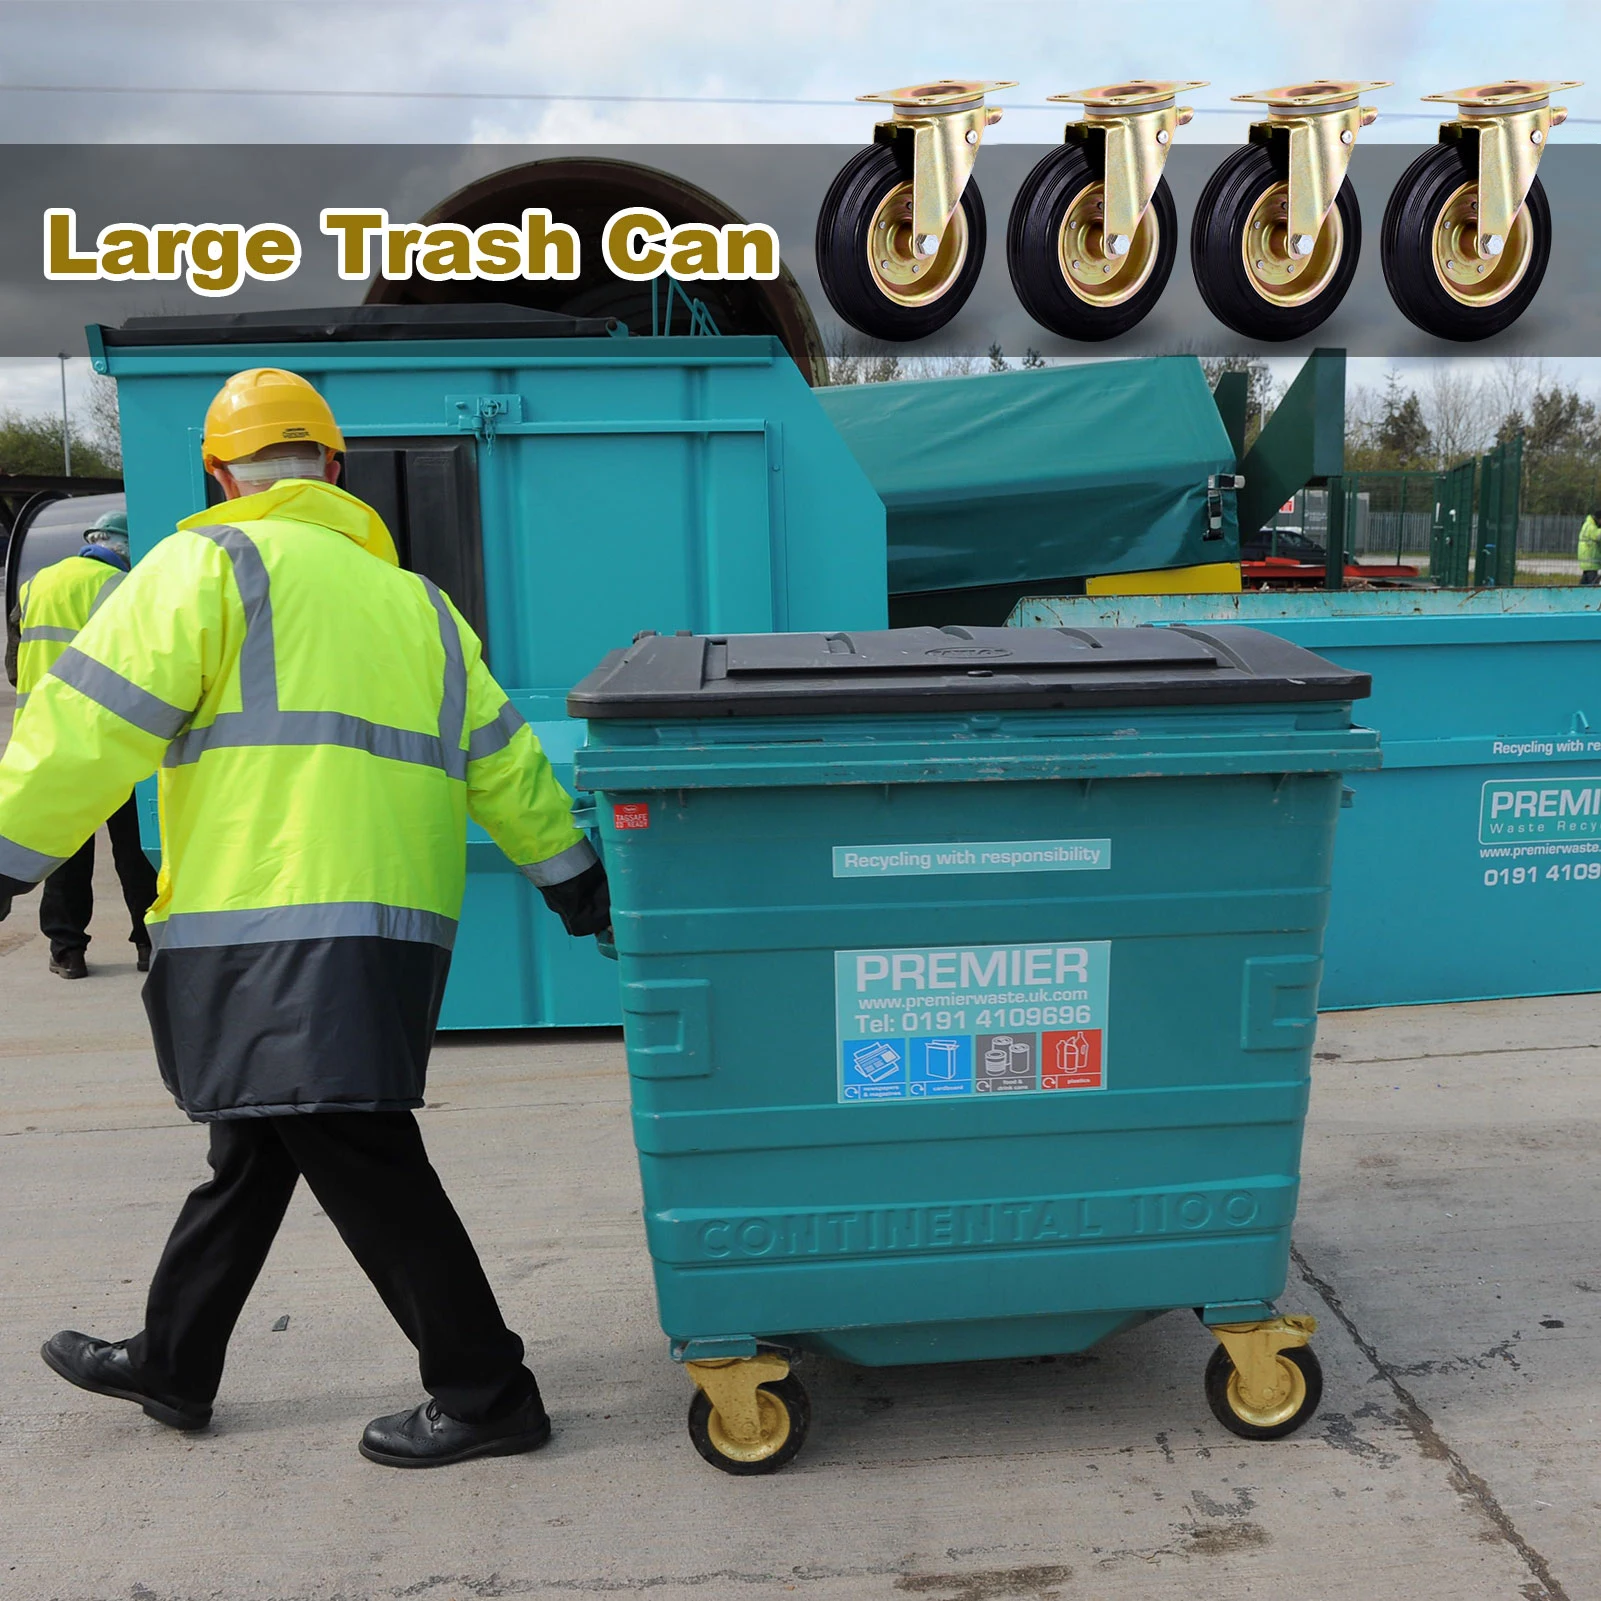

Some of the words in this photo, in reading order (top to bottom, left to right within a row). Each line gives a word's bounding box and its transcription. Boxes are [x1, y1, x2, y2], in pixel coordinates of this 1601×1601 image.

[1493, 741, 1553, 756] Recycling
[1556, 740, 1584, 752] with
[1491, 788, 1601, 819] PREMI
[1489, 822, 1545, 834] Waste
[1557, 820, 1601, 832] Recy
[844, 851, 931, 870] Recycling
[936, 850, 976, 866] with
[981, 846, 1100, 867] responsibility
[1484, 866, 1537, 886] 0191
[1545, 863, 1601, 882] 4109
[856, 948, 1089, 992] PREMIER
[858, 988, 1088, 1011] www.premierwaste.uk.com
[855, 1013, 895, 1034] Tel:
[902, 1010, 966, 1032] 0191
[976, 1004, 1092, 1029] 4109696
[701, 1198, 1103, 1258] CONTINENTAL
[1131, 1191, 1258, 1233] 1100
